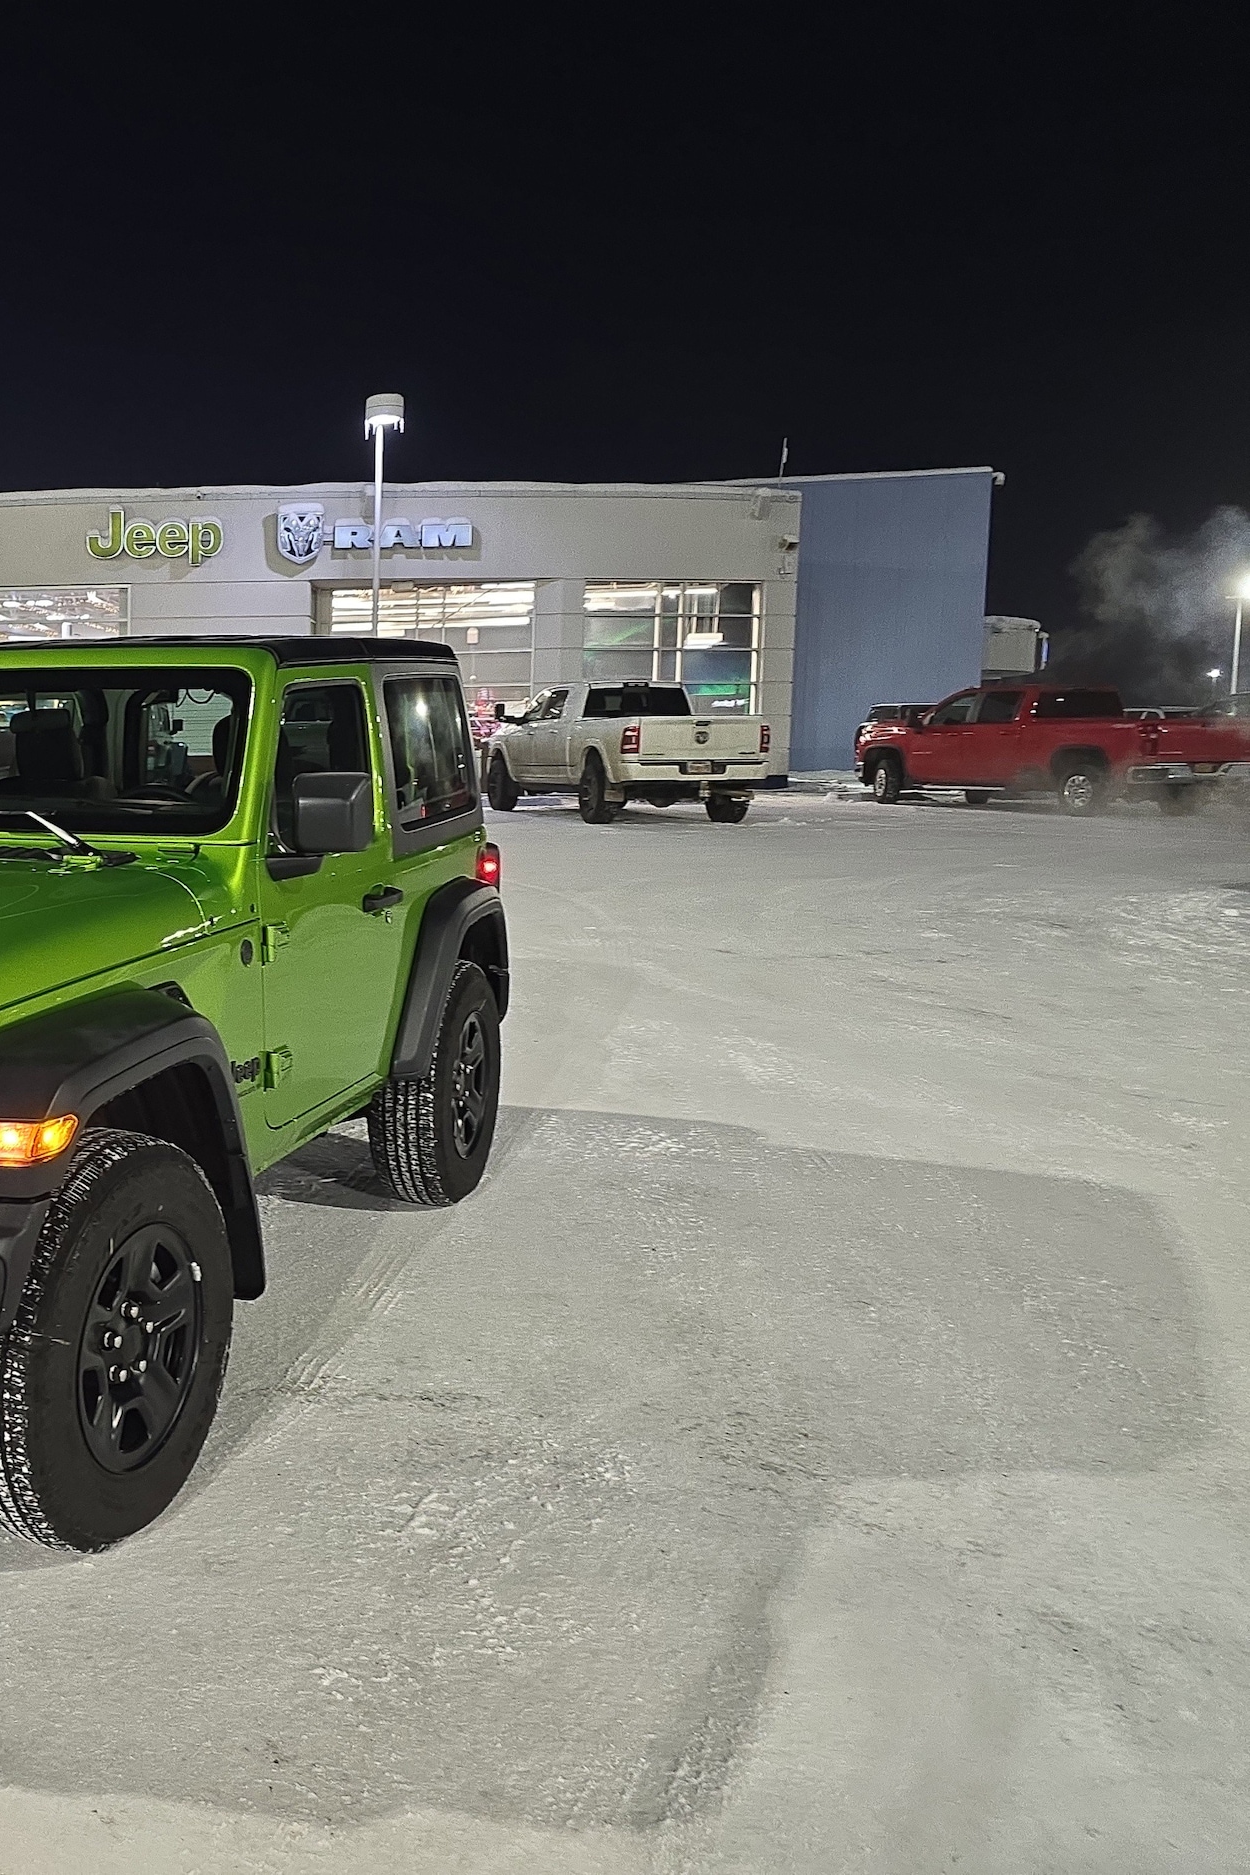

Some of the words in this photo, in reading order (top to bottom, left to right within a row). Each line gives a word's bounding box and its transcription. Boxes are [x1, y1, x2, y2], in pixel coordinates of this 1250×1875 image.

[86, 510, 224, 566] Jeep
[334, 524, 472, 549] RAM
[230, 1056, 261, 1084] Jeep
